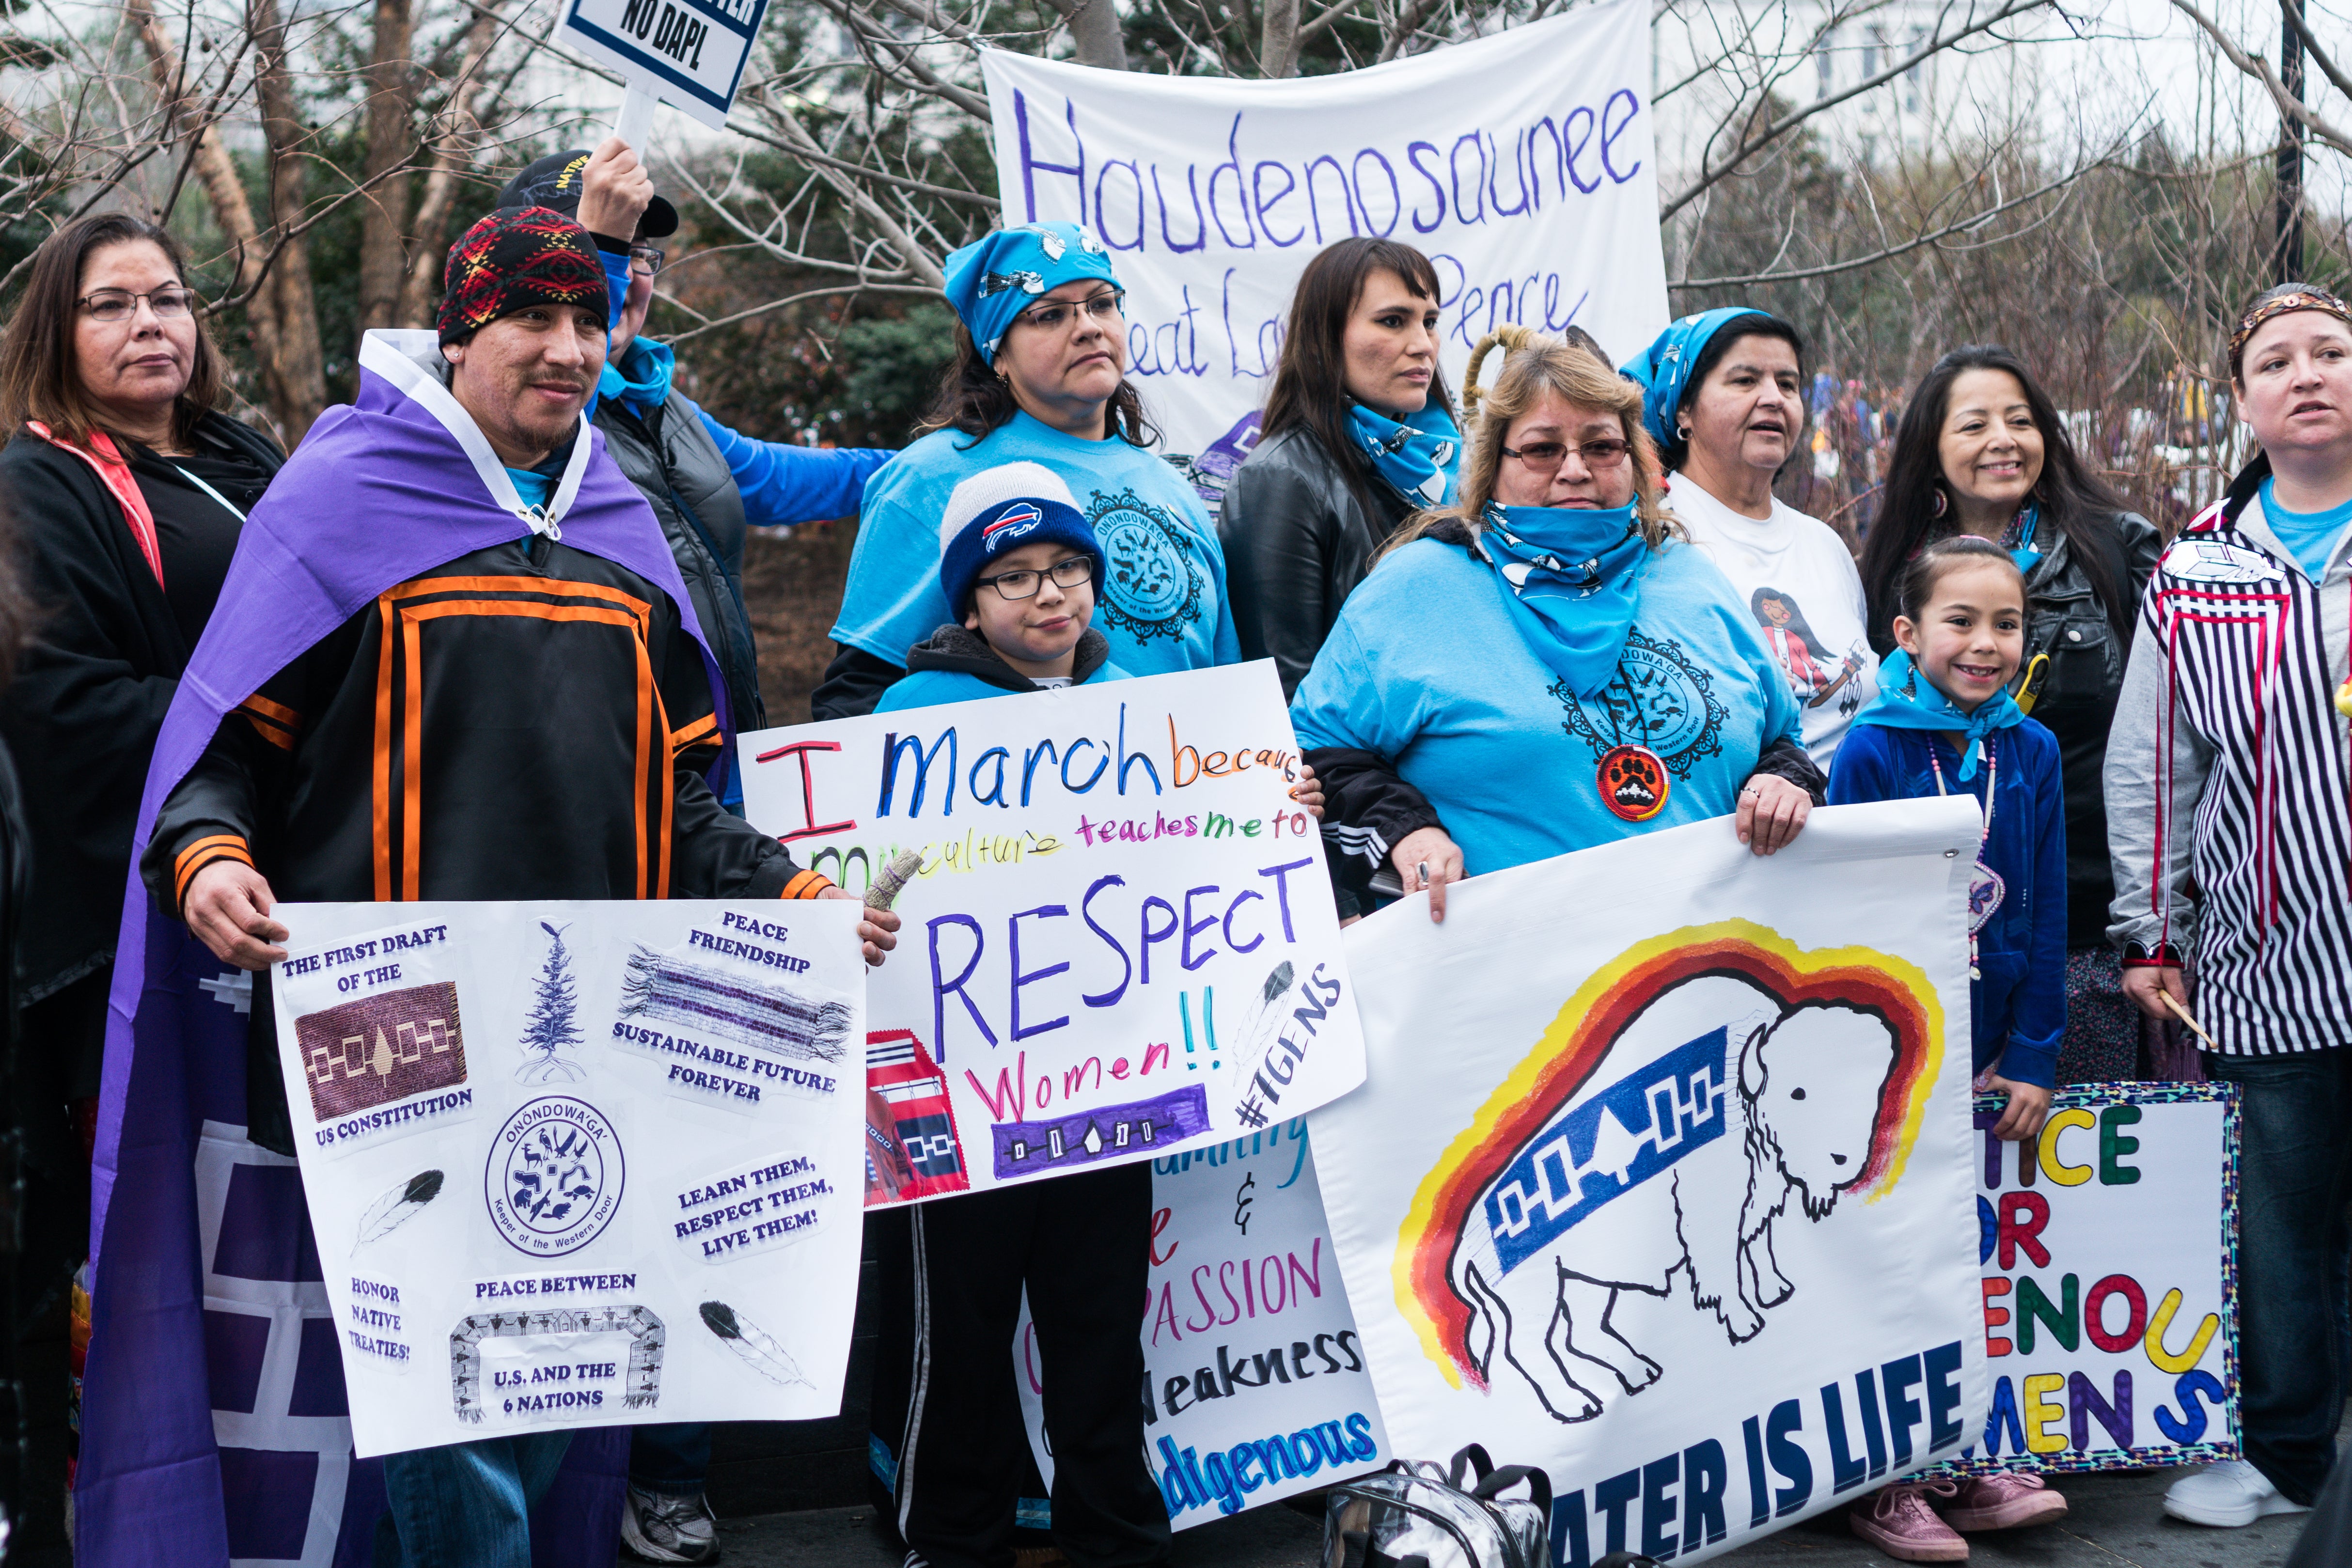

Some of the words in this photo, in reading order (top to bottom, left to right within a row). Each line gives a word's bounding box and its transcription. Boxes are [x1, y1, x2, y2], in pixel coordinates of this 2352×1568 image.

[620, 0, 658, 40] NO
[652, 2, 708, 71] DAPL
[556, 155, 590, 189] NATIVE
[1013, 87, 1641, 254] Haudenosaunee
[1223, 267, 1290, 379] La
[1595, 719, 1618, 741] Keepe
[1655, 735, 1688, 751] Western
[1687, 716, 1700, 734] Door
[755, 740, 857, 843] I
[1074, 808, 1198, 849] teaches
[1203, 811, 1264, 839] me
[1271, 808, 1307, 839] to
[282, 955, 321, 978] THE
[325, 941, 377, 967] FIRST
[382, 924, 447, 953] DRAFT
[722, 911, 788, 942] PEACE
[689, 929, 811, 974] FRIENDSHIP
[926, 857, 1313, 1064] RESPECT
[337, 973, 360, 992] OF
[364, 963, 402, 986] THE
[612, 1022, 750, 1070] SUSTAINABLE
[752, 1058, 836, 1093] FUTURE
[1235, 963, 1341, 1129] #7GENS
[668, 1064, 761, 1101] FOREVER
[315, 1128, 334, 1146] US
[337, 1088, 473, 1138] CONSTITUTION
[678, 1174, 747, 1208] LEARN
[750, 1156, 816, 1185] THEM,
[494, 1198, 516, 1233] Keeper
[518, 1234, 530, 1244] of
[533, 1239, 549, 1249] the
[554, 1223, 595, 1248] Western
[594, 1194, 613, 1221] Door
[674, 1197, 764, 1238] RESPECT
[767, 1178, 833, 1207] THEM,
[701, 1229, 751, 1256] LIVE
[752, 1209, 818, 1239] THEM!
[351, 1277, 400, 1302] HONOR
[475, 1279, 536, 1298] PEACE
[541, 1273, 637, 1293] BETWEEN
[351, 1304, 401, 1331] NATIVE
[348, 1330, 410, 1361] TREATIES!
[494, 1370, 527, 1387] U.S.
[531, 1365, 571, 1381] AND
[575, 1362, 616, 1379] THE
[503, 1398, 514, 1413] 6
[517, 1390, 603, 1411] NATIONS
[1742, 1398, 1813, 1530] IS
[1819, 1340, 1962, 1495] LIFE
[1155, 1412, 1378, 1521] digenous
